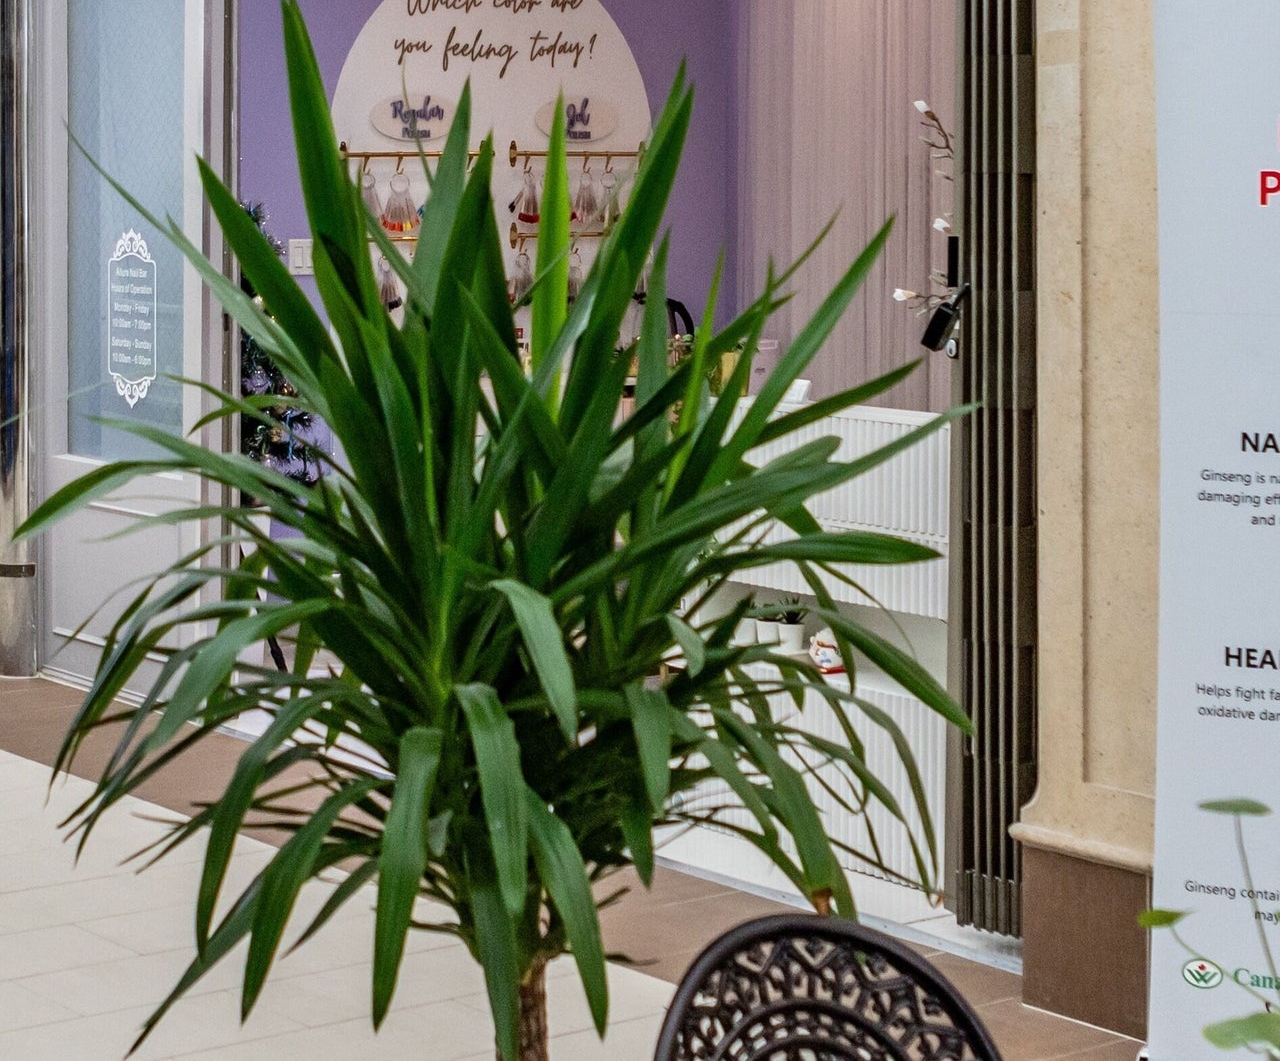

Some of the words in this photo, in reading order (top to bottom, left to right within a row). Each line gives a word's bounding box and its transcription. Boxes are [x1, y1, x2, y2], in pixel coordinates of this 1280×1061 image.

[394, 36, 433, 65] you
[443, 26, 519, 79] feeling
[390, 95, 445, 130] Regular
[1200, 469, 1252, 486] Ginseng
[1256, 471, 1266, 484] is
[1198, 490, 1261, 507] damaging
[1251, 514, 1276, 526] and
[1195, 683, 1231, 699] Helps
[1235, 686, 1266, 701] fight
[1198, 705, 1256, 721] oxidative
[1184, 880, 1236, 899] Ginseng
[1254, 910, 1279, 926] may
